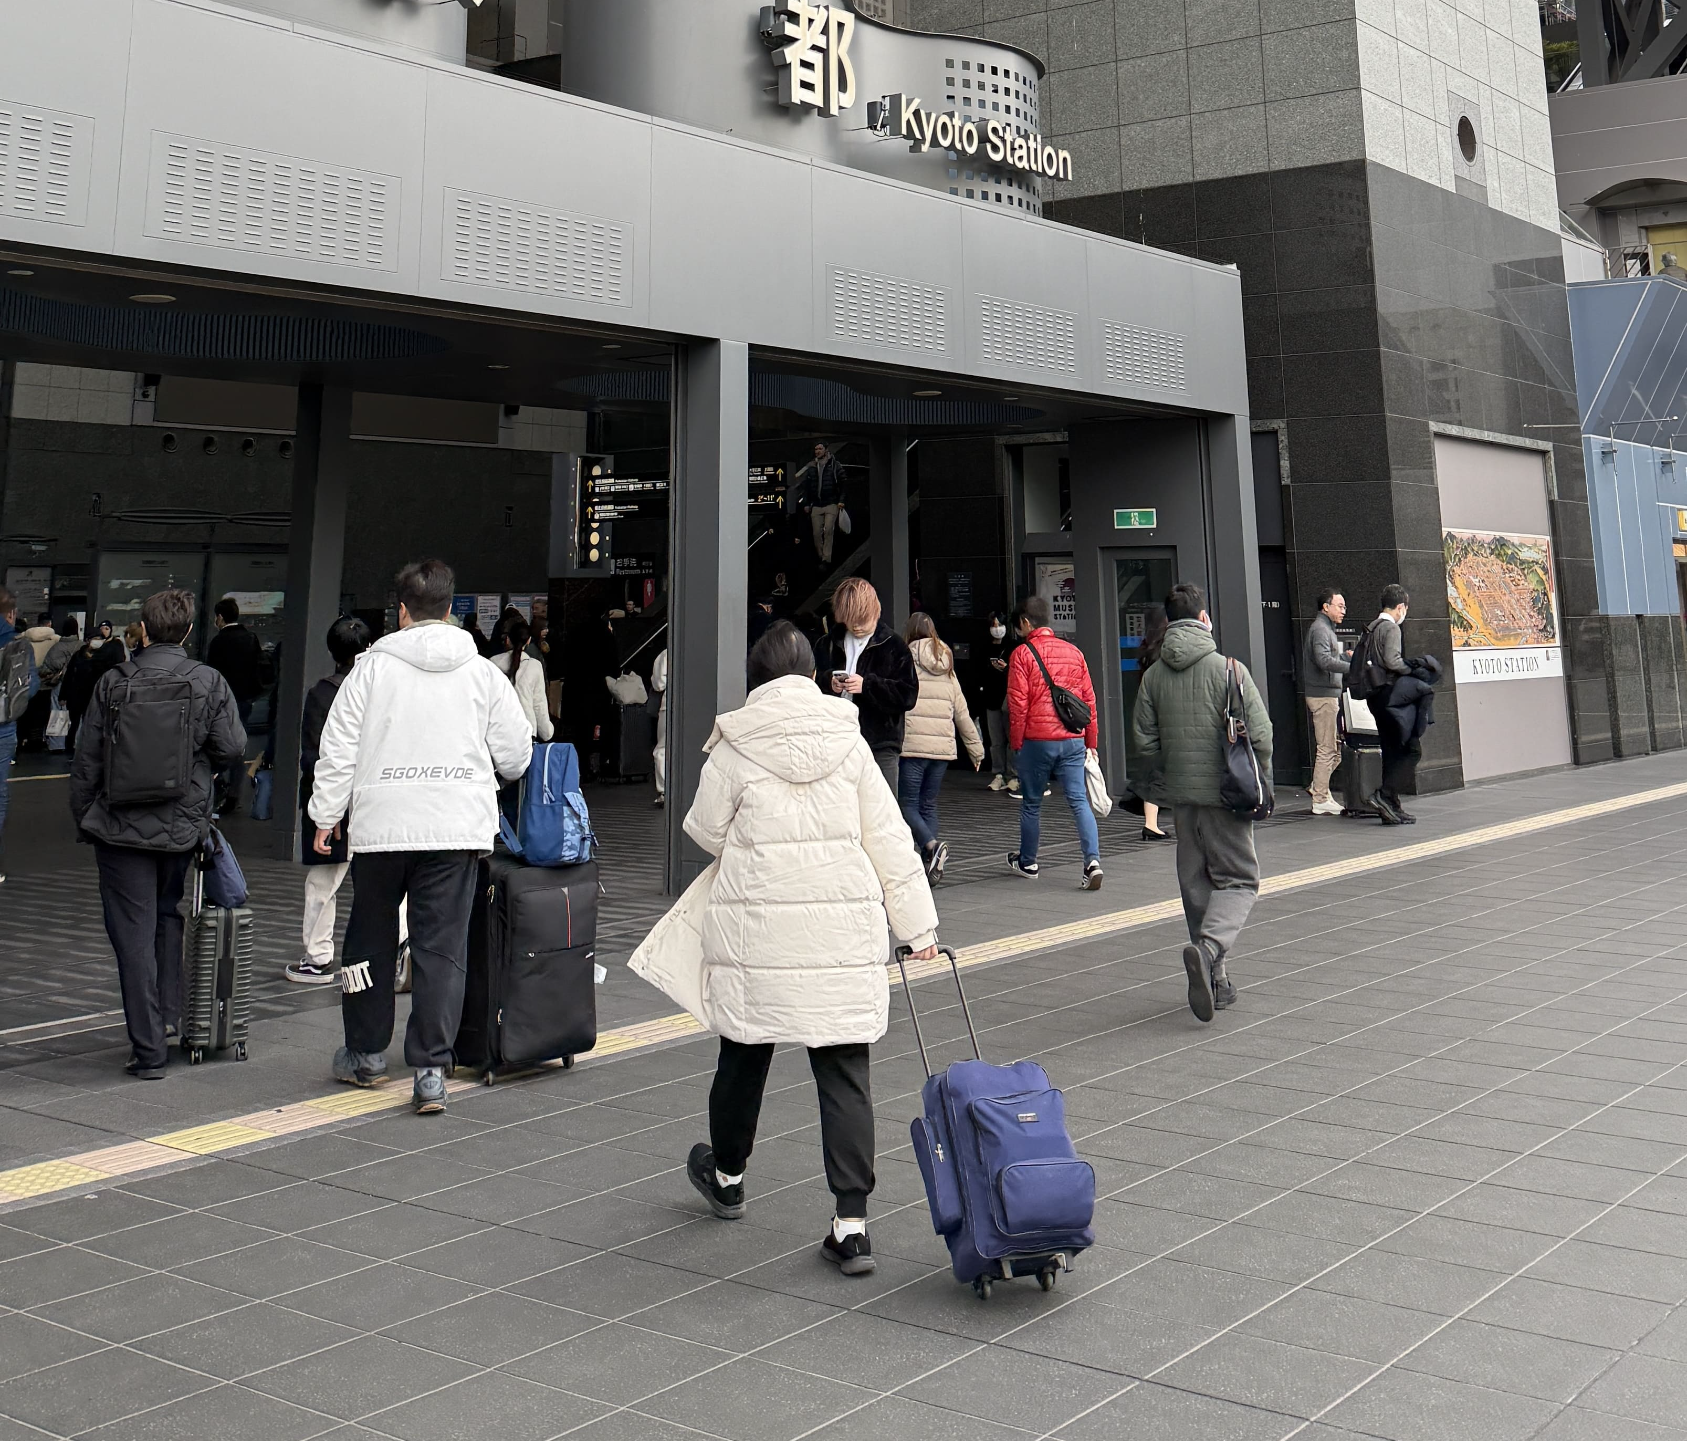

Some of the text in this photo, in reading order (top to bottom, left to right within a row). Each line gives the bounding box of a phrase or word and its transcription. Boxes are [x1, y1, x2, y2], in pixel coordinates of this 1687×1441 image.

[894, 93, 1073, 181] Kyoto Station
[1472, 656, 1540, 675] KYOTO STATION
[379, 766, 474, 780] SGOXEVDE
